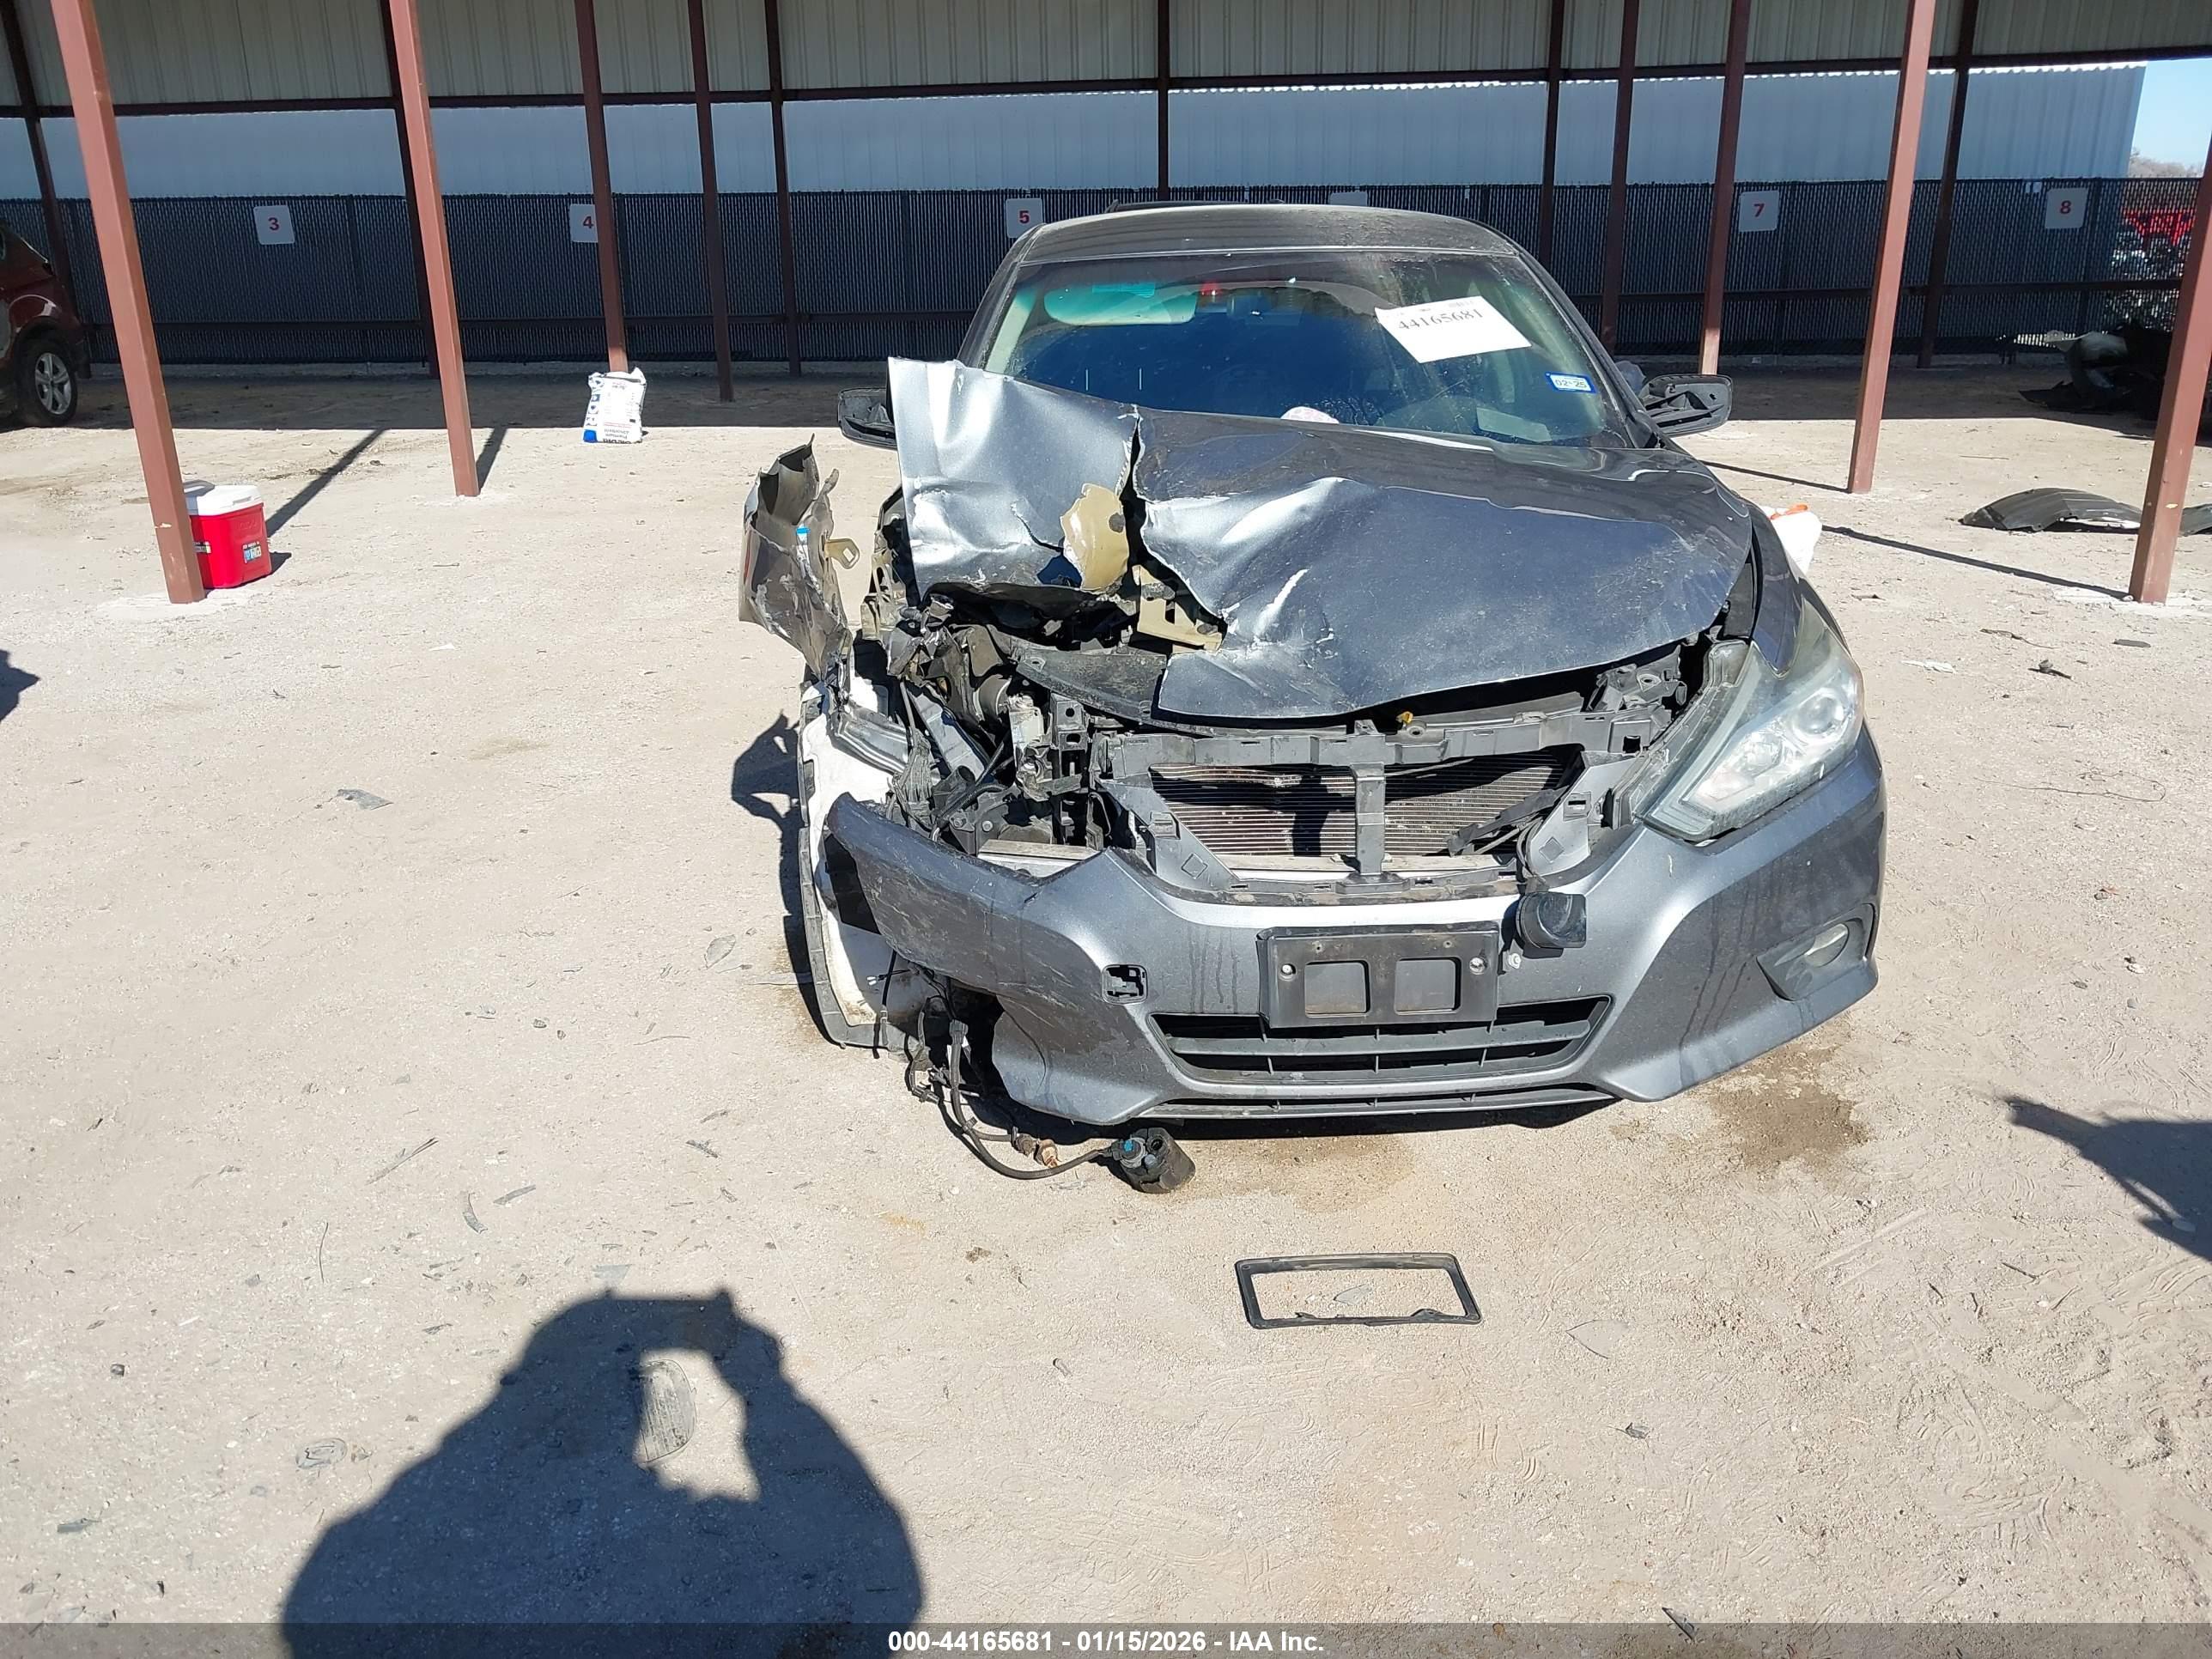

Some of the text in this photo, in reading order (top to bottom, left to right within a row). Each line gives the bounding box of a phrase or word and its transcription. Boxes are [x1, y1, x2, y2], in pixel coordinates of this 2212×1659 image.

[1753, 203, 1765, 217] 7
[2059, 200, 2071, 214] 8
[268, 216, 280, 231] 3
[582, 216, 594, 229] 4
[1018, 210, 1030, 224] 5
[1398, 308, 1484, 330] 44165681
